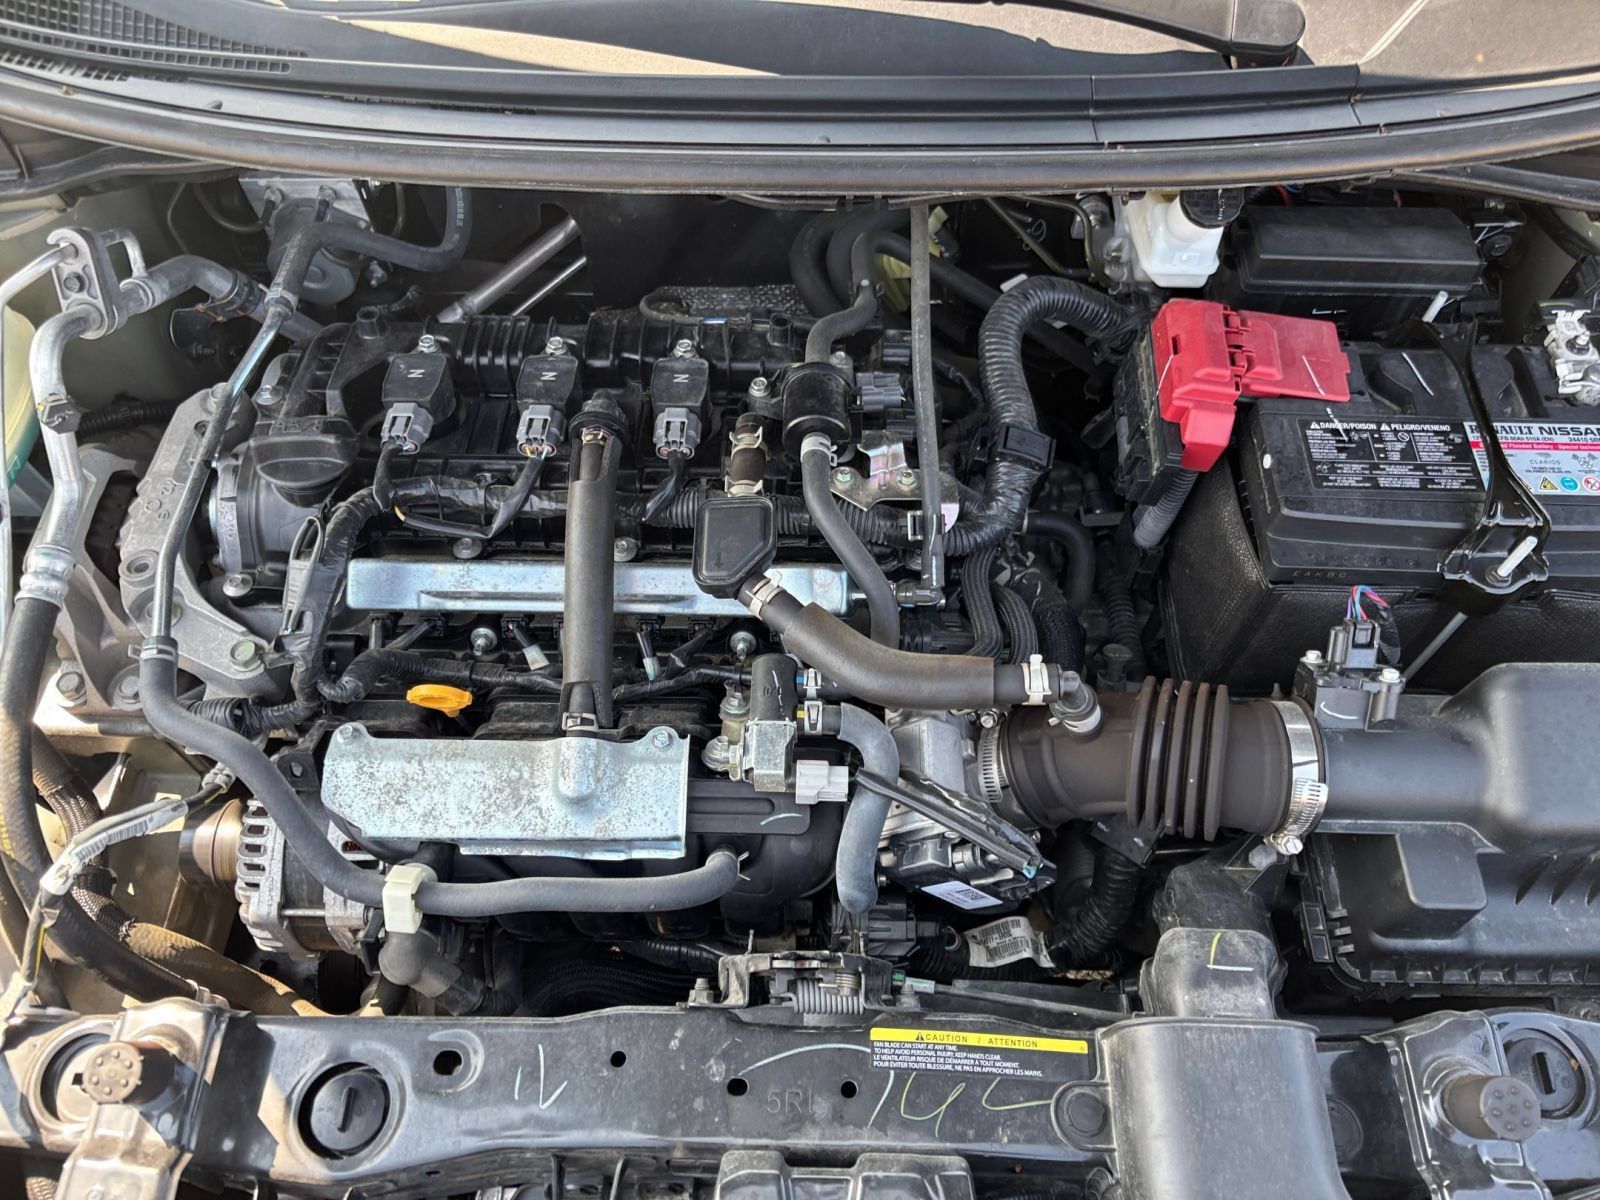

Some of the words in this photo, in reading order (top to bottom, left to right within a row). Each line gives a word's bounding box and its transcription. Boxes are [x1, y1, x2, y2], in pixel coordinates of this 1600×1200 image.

[1468, 424, 1534, 436] RAULT
[926, 1033, 968, 1042] CAUTION
[989, 1038, 1038, 1048] ATTENTION
